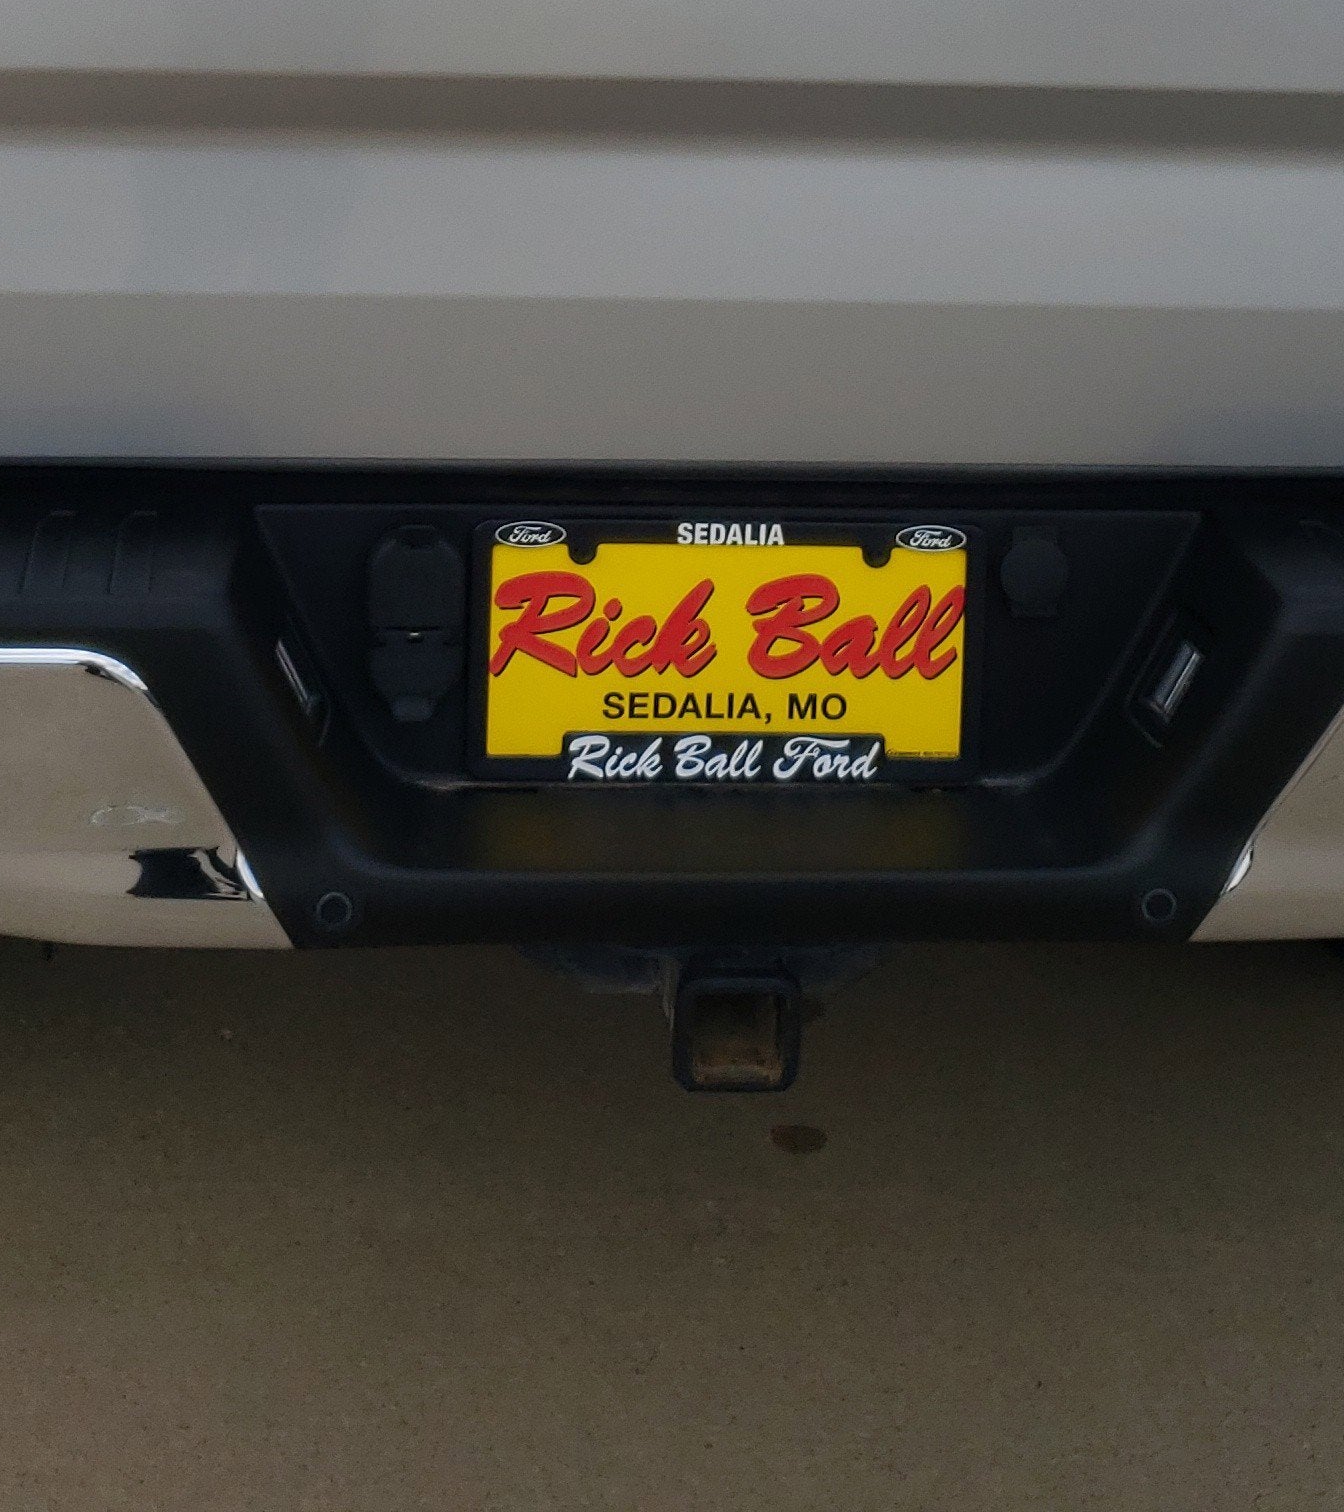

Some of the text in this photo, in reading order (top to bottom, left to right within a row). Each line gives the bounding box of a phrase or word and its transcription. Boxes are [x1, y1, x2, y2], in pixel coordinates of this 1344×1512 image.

[509, 525, 553, 543] Ford
[676, 522, 785, 547] SEDALIA
[909, 529, 953, 548] Ford
[489, 570, 967, 680] Rick Ball
[601, 691, 848, 725] SEDALIA, MO
[567, 734, 881, 780] Rick Ball Ford
